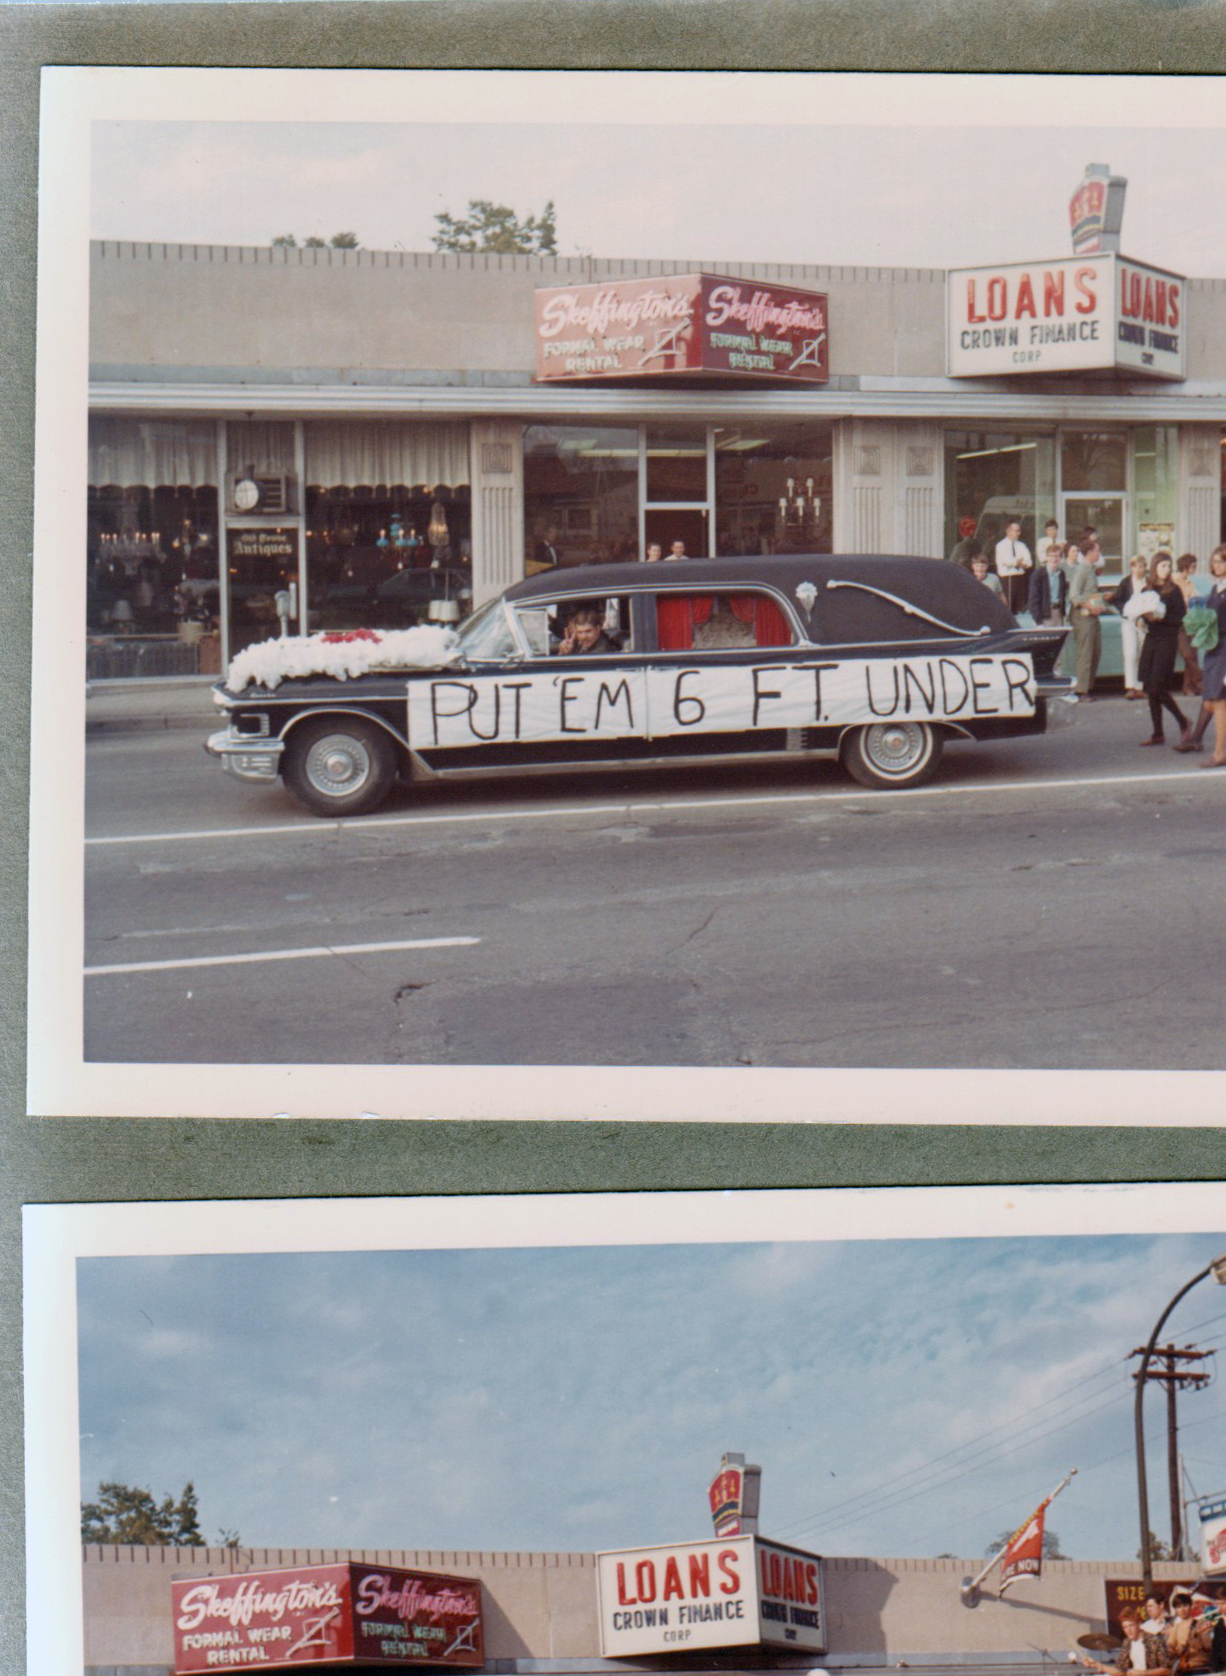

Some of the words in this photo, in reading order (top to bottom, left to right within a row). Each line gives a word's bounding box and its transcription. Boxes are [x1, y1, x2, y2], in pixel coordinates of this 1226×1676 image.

[966, 267, 1097, 324] LOANS
[1121, 268, 1180, 329] LOANS
[543, 338, 596, 359] FORMAL
[603, 334, 645, 353] WEAR
[710, 333, 757, 351] FORMAL
[960, 327, 1019, 350] CROWN
[1030, 320, 1100, 344] FINANCE
[565, 355, 623, 372] RENTAL
[729, 353, 776, 370] RENTAL
[1013, 350, 1042, 363] CORP
[233, 540, 292, 557] Antiques
[431, 681, 533, 746] PUT
[553, 675, 635, 733] 'EM
[673, 670, 706, 727] 6
[866, 658, 1035, 717] UNDER
[615, 1549, 741, 1606] LOANS
[761, 1549, 818, 1606] LOANS
[177, 1580, 343, 1630] Skeffington's
[612, 1607, 669, 1630] CROWN
[679, 1600, 745, 1624] FINANCE
[182, 1630, 243, 1650] FORMAL
[248, 1625, 293, 1643] WEAR
[361, 1621, 410, 1640] FORMAL
[413, 1625, 447, 1641] WEAR
[663, 1630, 692, 1642] CORP
[207, 1645, 270, 1666] RENTAL
[381, 1641, 430, 1658] RENTAL
